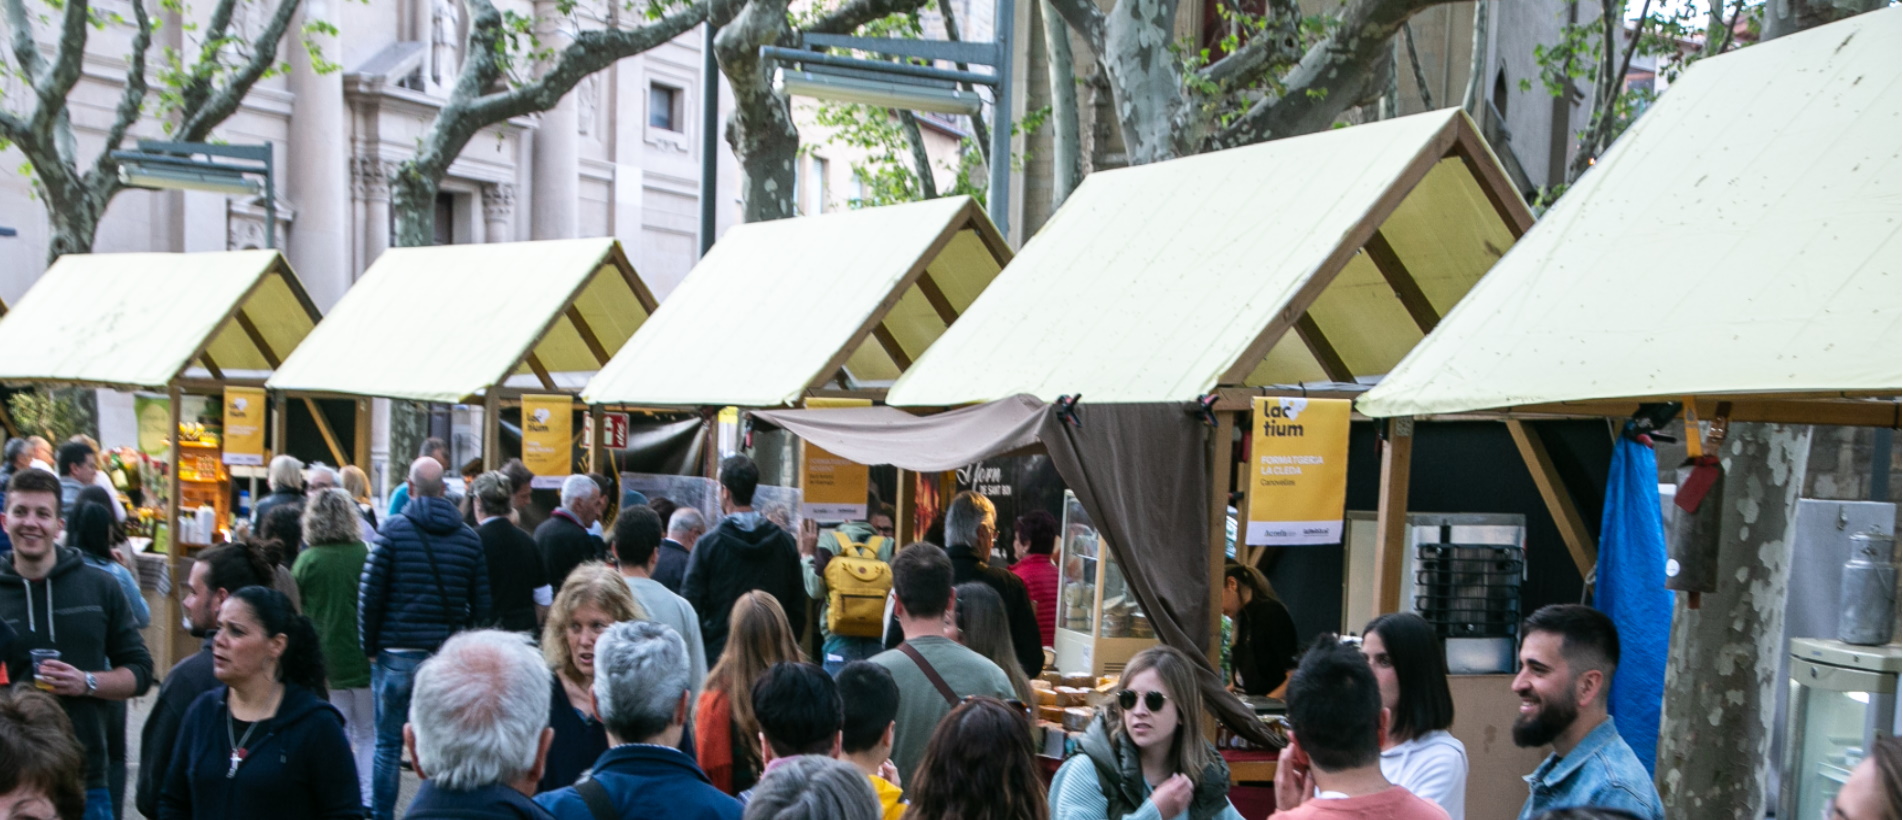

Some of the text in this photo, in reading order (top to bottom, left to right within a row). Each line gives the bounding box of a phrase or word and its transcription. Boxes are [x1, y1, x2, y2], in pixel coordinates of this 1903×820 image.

[1263, 400, 1292, 418] lac
[1263, 420, 1304, 437] tium
[1261, 455, 1324, 465] FORMATGERIA
[1261, 466, 1302, 475] LA CLEDA
